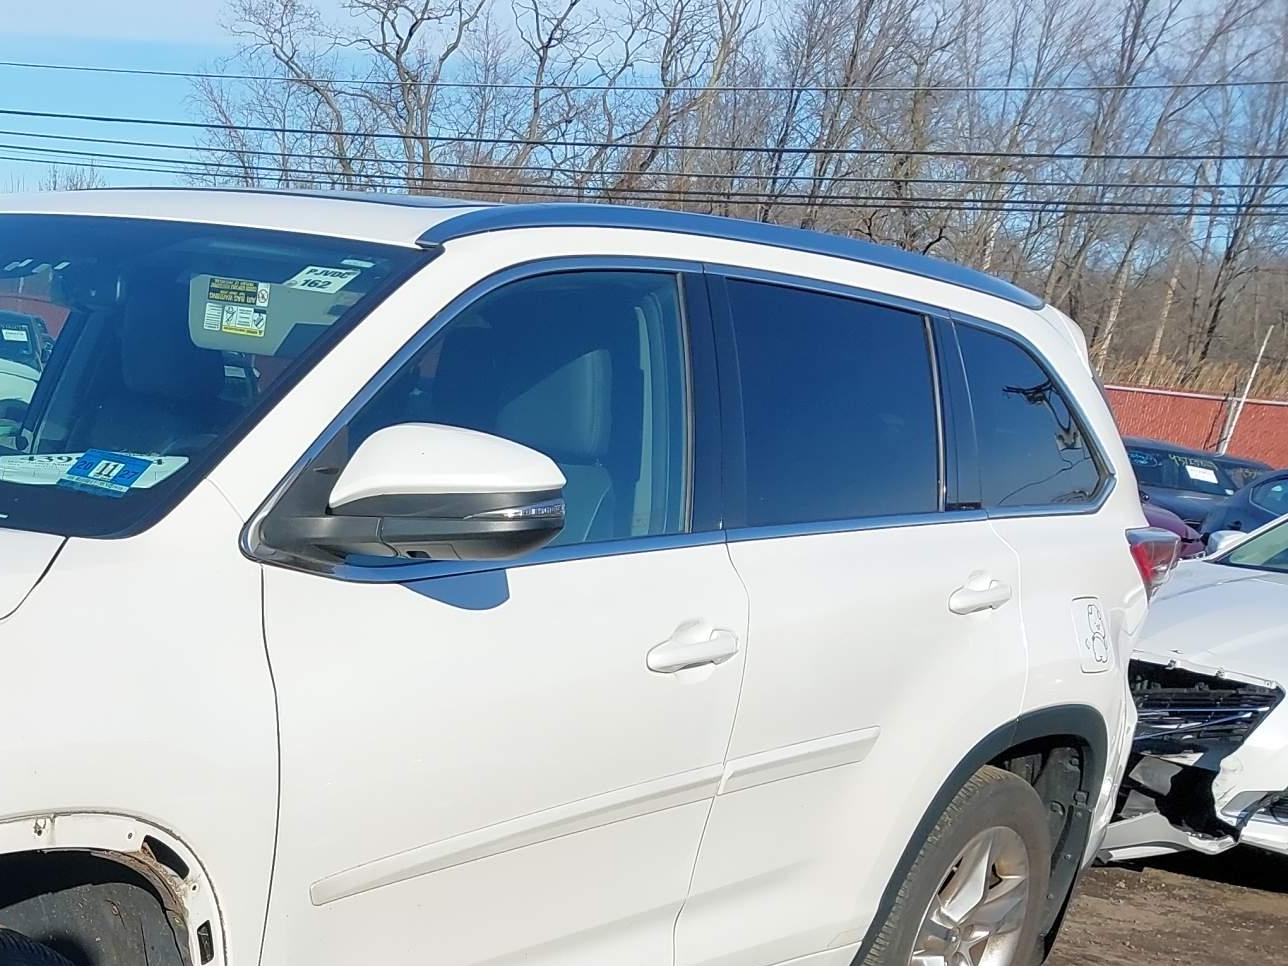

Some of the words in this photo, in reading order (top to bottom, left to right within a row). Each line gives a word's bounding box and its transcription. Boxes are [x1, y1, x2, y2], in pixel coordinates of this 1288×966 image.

[300, 279, 332, 289] 162
[76, 460, 93, 470] 20
[95, 462, 120, 478] 11
